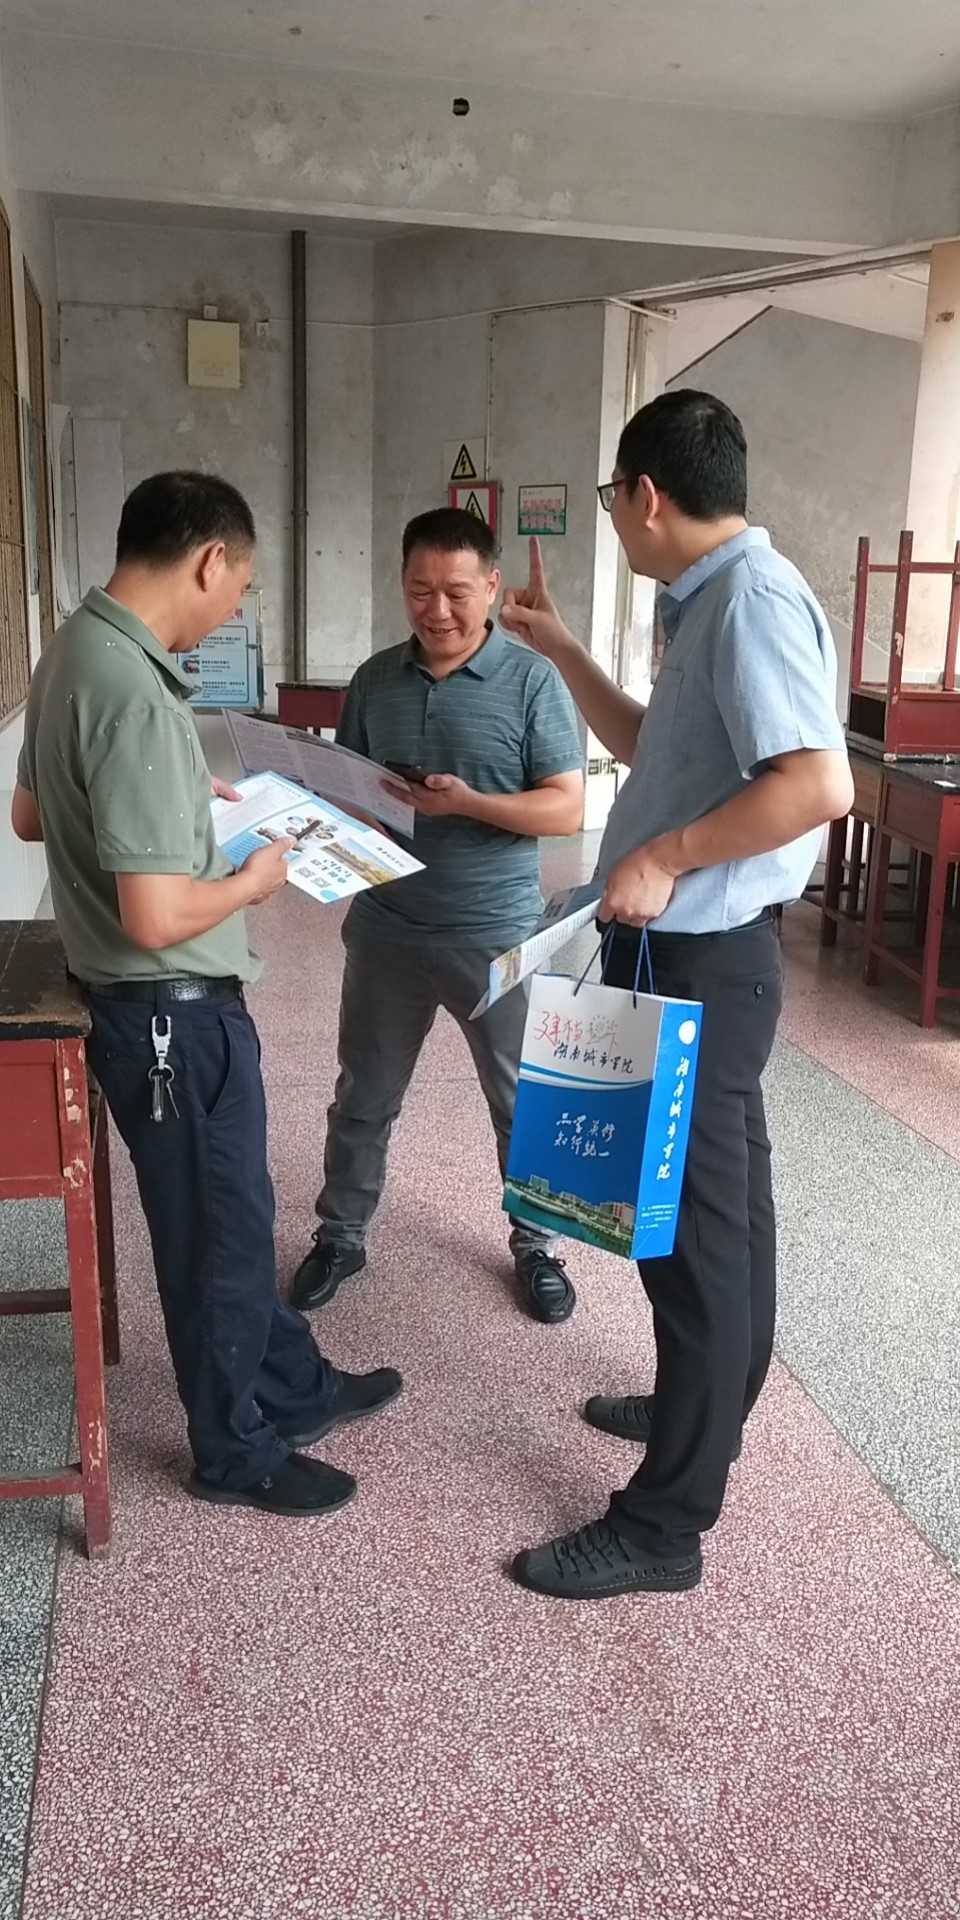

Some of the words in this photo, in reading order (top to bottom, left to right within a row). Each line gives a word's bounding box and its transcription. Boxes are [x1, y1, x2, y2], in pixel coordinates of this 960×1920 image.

[553, 1040, 633, 1074] 湖南城市学院
[656, 1056, 690, 1180] 湖南城市学院
[554, 1130, 610, 1157] 知行统一
